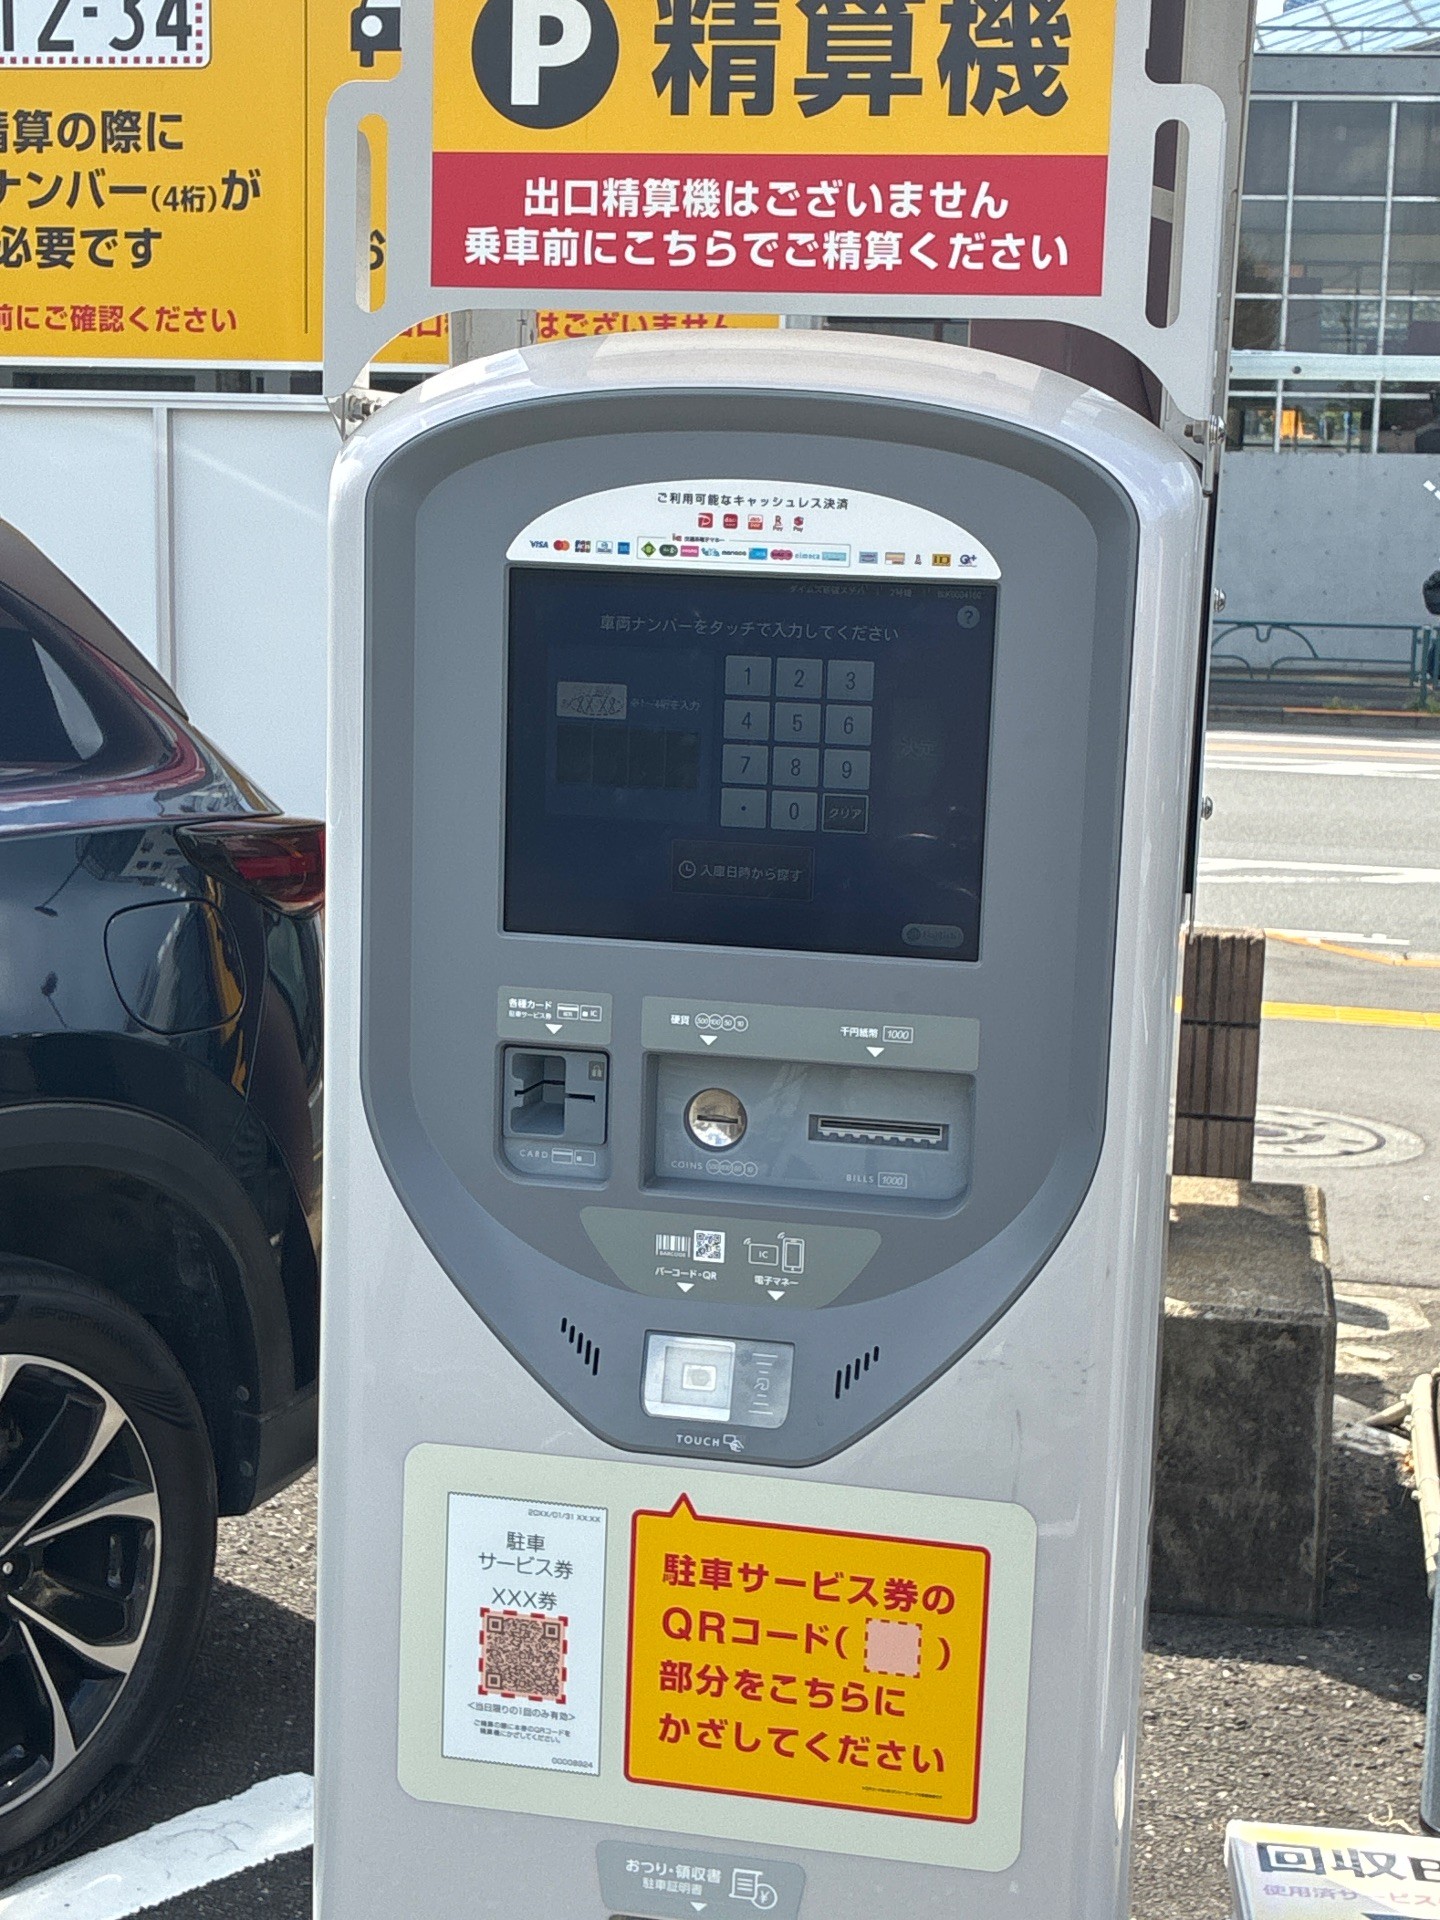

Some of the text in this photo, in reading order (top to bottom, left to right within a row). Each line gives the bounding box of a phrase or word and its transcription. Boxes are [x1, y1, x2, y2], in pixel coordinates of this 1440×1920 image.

[511, 0, 592, 105] P
[652, 0, 1071, 118] 精算機
[523, 177, 1010, 219] 出口精算機はございません
[0, 225, 163, 269] 必要です
[463, 225, 1070, 271] 乗車前にこちらでご精算ください
[657, 492, 849, 510] ご利用可能なキャッシュレス決済
[529, 540, 549, 549] VISA
[600, 614, 900, 642] 車両ナンバーをタッチで入力してください
[744, 667, 751, 686] 1
[794, 669, 805, 688] 2
[845, 672, 856, 691] 3
[741, 711, 752, 730] 4
[792, 714, 803, 732] 5
[843, 716, 854, 735] 6
[741, 756, 751, 774] 7
[791, 758, 801, 776] 8
[842, 760, 852, 779] 9
[789, 802, 799, 820] 0
[700, 864, 803, 883] 入庫日時から探す
[508, 997, 553, 1010] 各種カード
[840, 1026, 879, 1038] 千円紙幣
[887, 1029, 910, 1040] 1000
[519, 1149, 549, 1159] CARD
[671, 1160, 703, 1171] COINS
[846, 1173, 874, 1184] BILLS
[758, 1250, 769, 1259] IC
[754, 1275, 800, 1287] 電子マネー
[676, 1433, 720, 1447] TOUCH
[506, 1531, 546, 1553] 駐車
[478, 1553, 574, 1580] サービス券
[662, 1552, 956, 1615] 駐車サービス券の
[491, 1586, 558, 1611] XXX券
[658, 1659, 906, 1718] 部分をこちらに
[657, 1713, 945, 1774] かざしてください
[626, 1858, 722, 1884] おつり・領収書
[642, 1877, 703, 1896] 駐車証明書
